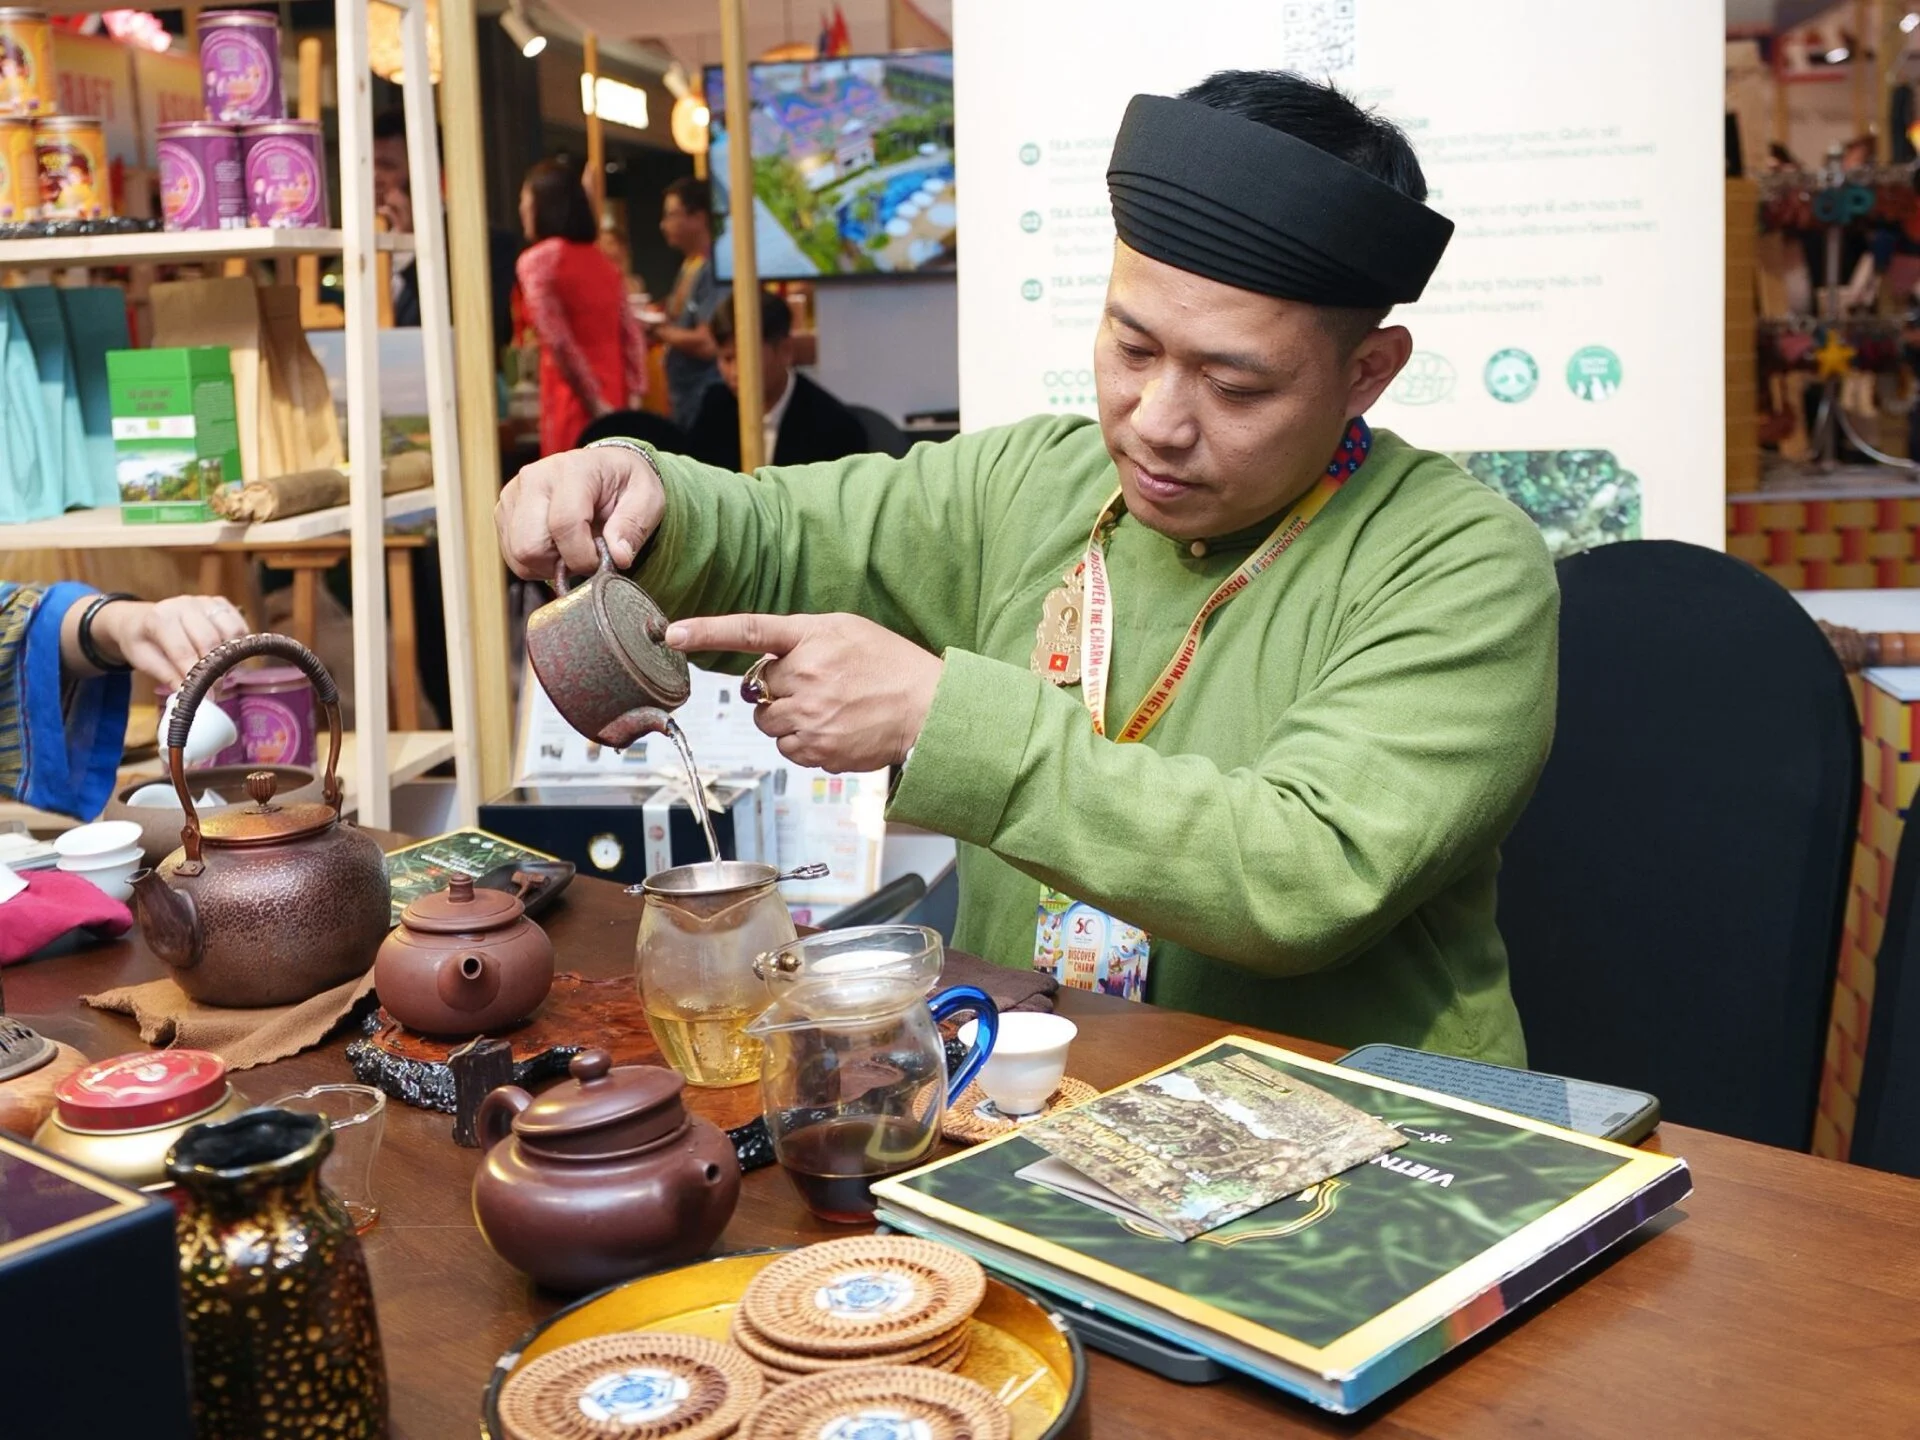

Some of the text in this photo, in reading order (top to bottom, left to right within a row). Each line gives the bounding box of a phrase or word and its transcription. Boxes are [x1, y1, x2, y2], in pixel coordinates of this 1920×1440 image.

[1078, 275, 1108, 287] SHO
[1043, 368, 1094, 388] OCO
[1090, 552, 1106, 606] DISCOVER
[1200, 574, 1248, 618] DISCOVER
[1090, 608, 1103, 625] THE
[1089, 627, 1106, 666] CHARM
[1169, 639, 1196, 681] CHARM
[1162, 678, 1175, 690] OF
[1125, 714, 1149, 739] NAM
[1067, 949, 1096, 962] DISCOVER
[1073, 961, 1095, 974] CHARM
[1370, 1154, 1456, 1188] VIETN
